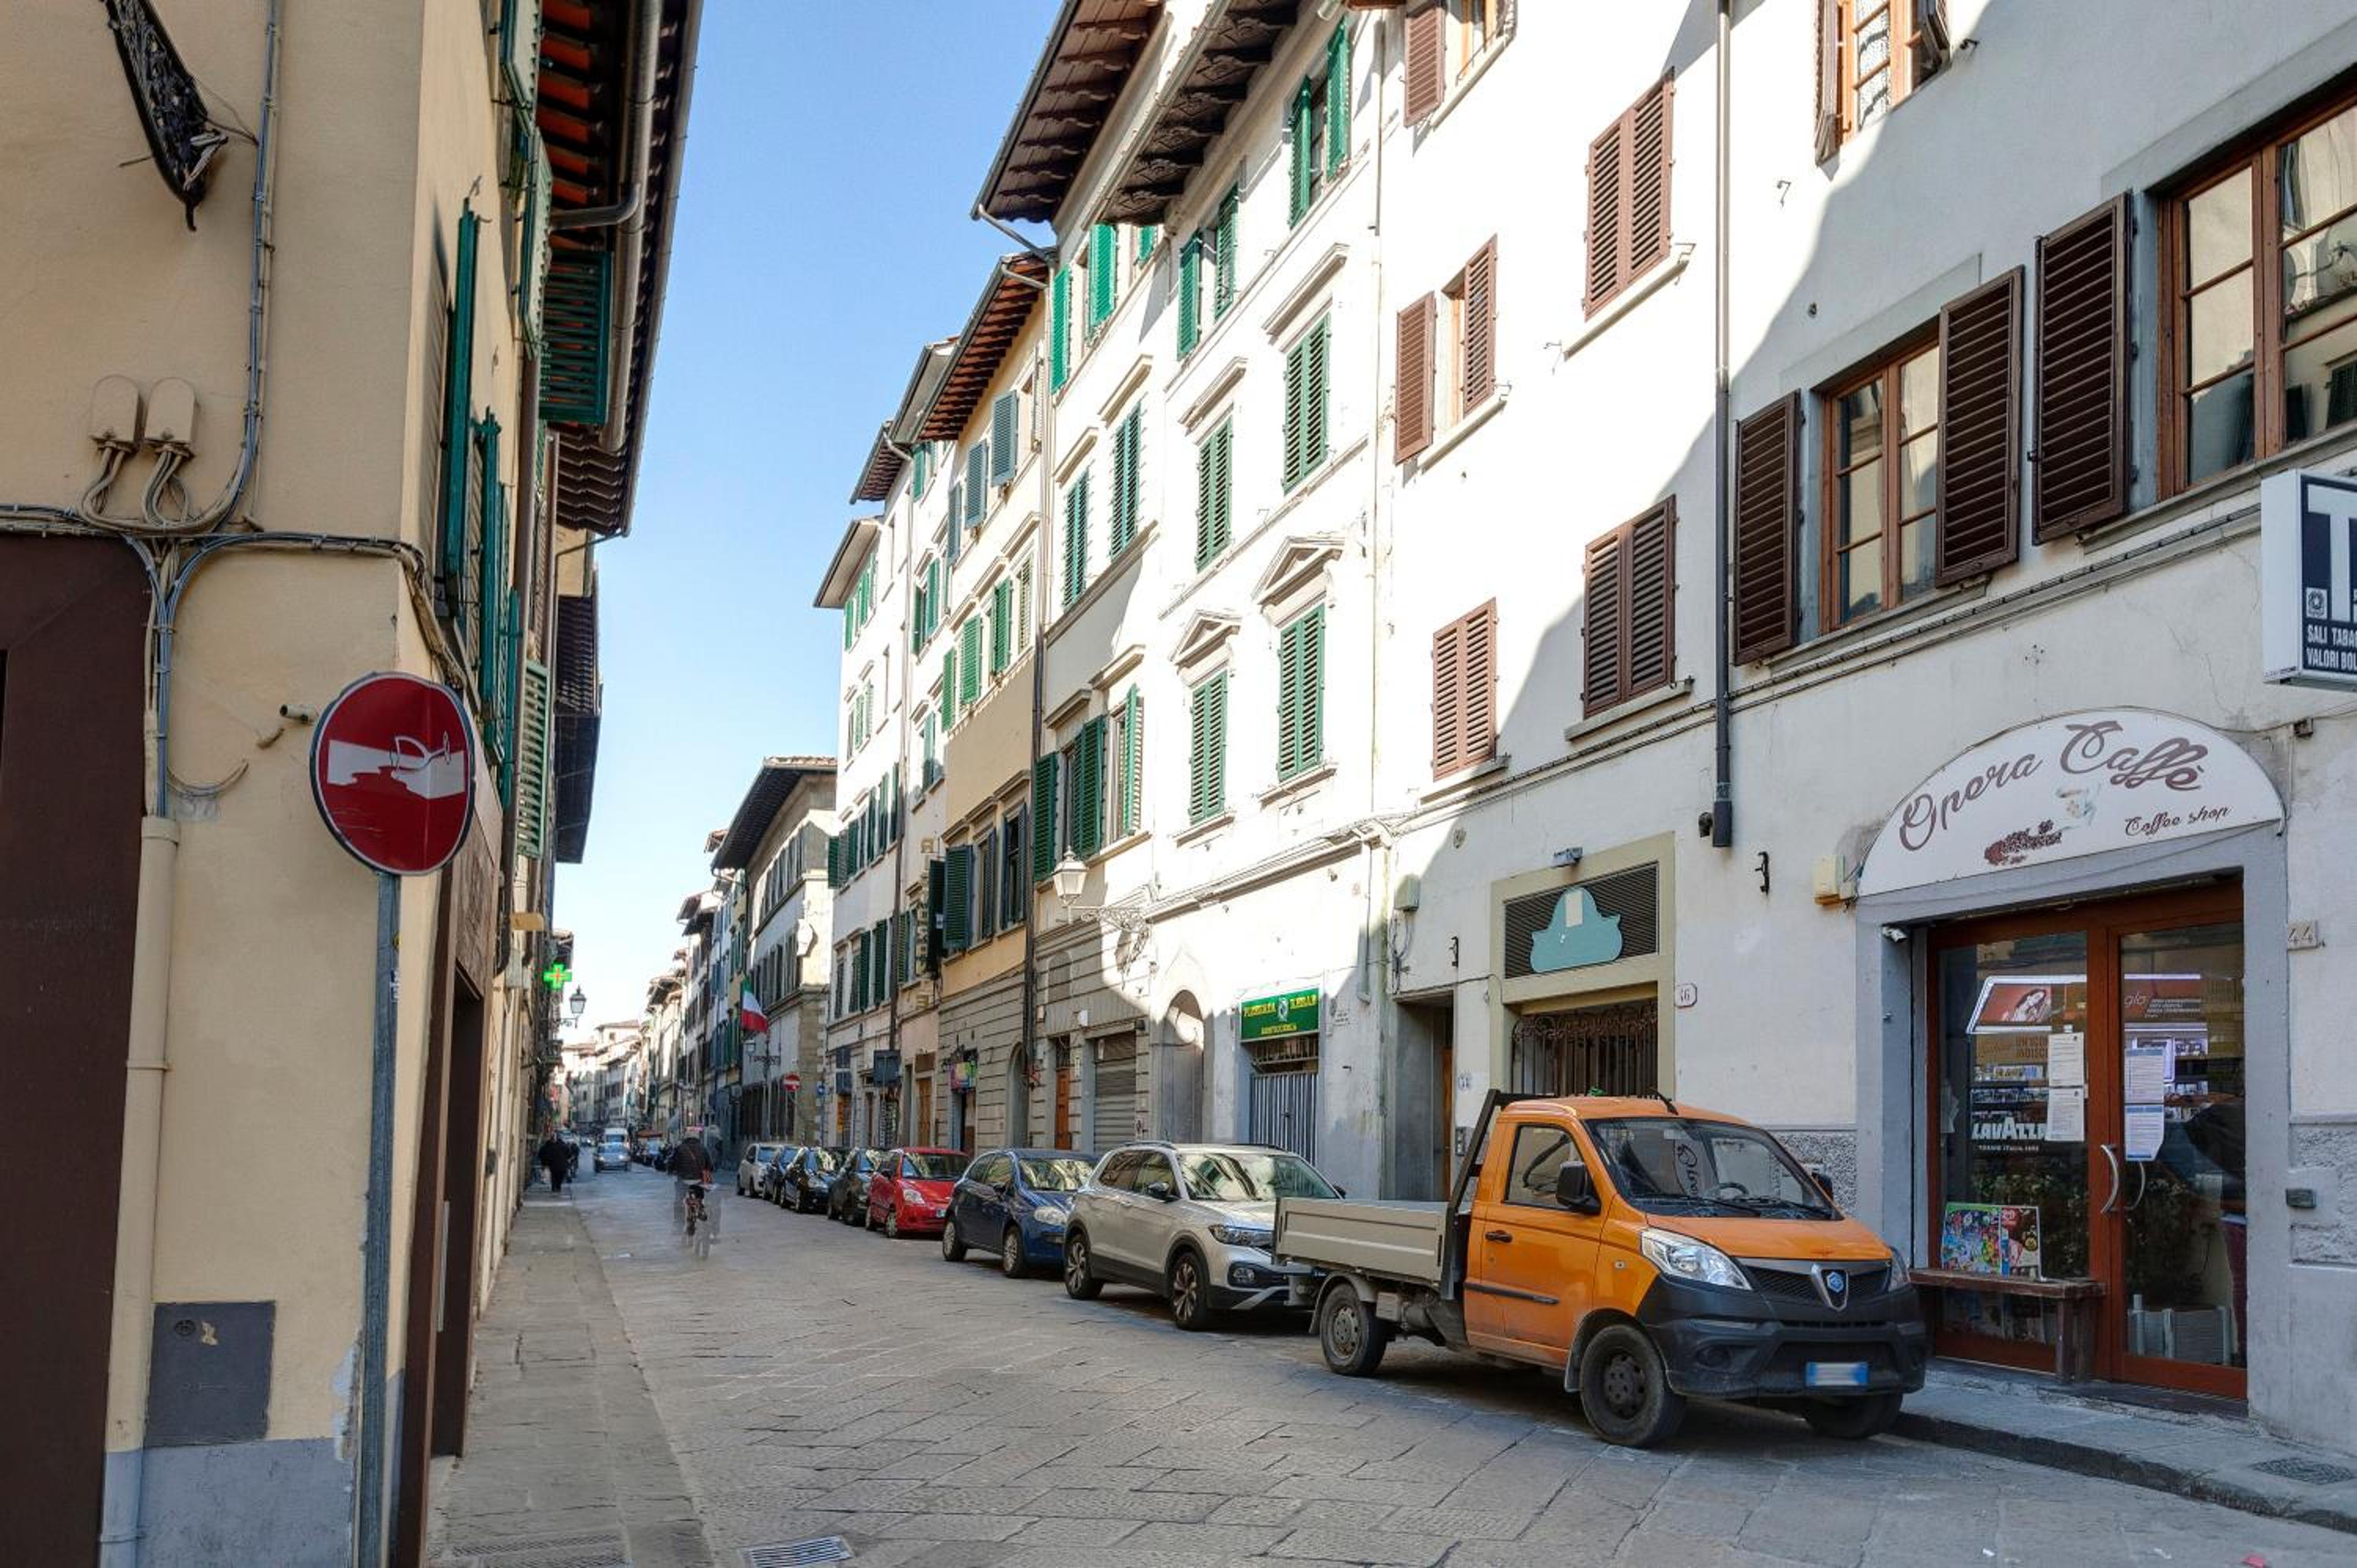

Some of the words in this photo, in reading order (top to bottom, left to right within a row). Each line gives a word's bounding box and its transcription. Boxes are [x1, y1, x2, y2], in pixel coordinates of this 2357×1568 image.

[2308, 624, 2327, 644] SALI
[2306, 647, 2339, 669] VALORI
[1899, 753, 2043, 851] Opera
[2124, 811, 2180, 836] Coffee
[2187, 805, 2231, 823] shop
